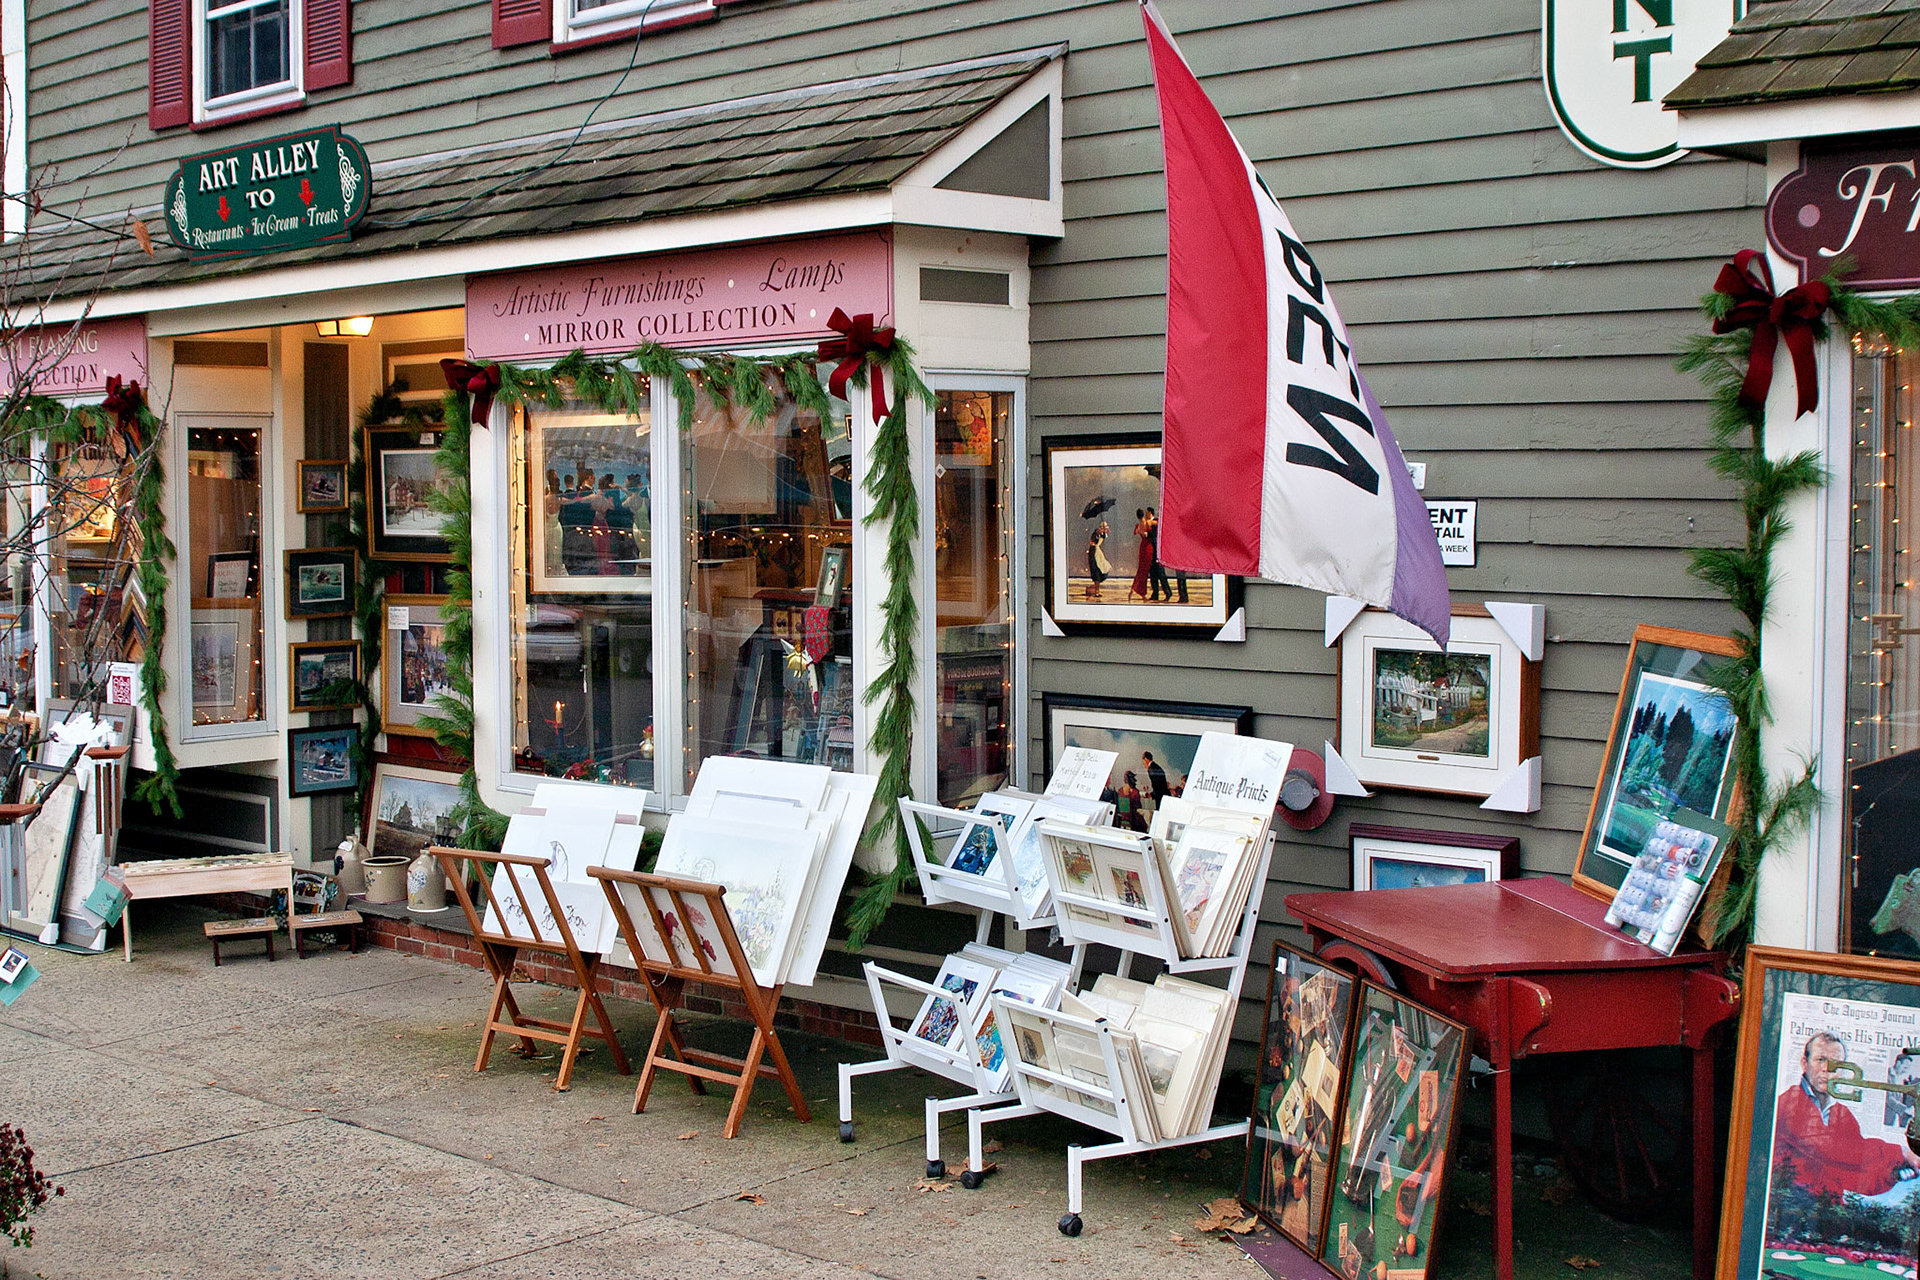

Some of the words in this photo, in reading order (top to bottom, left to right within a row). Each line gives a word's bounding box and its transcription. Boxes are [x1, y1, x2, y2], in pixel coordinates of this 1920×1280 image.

[199, 156, 240, 192] ART
[250, 139, 320, 181] ALLEY
[245, 188, 275, 209] TO
[192, 224, 245, 249] Restaurants
[306, 204, 339, 227] Treats
[493, 282, 571, 317] Artistic
[576, 269, 706, 317] Furnishings
[758, 257, 846, 292] Lamps
[538, 317, 625, 345] MIRROR
[637, 302, 797, 338] COLLECTION
[1192, 769, 1235, 798] Antique
[1236, 777, 1269, 802] Prints
[1822, 1002, 1839, 1016] The
[1842, 1004, 1878, 1020] Augusta
[1880, 1008, 1916, 1024] Journal
[1790, 1020, 1823, 1036] Palm
[1826, 1025, 1852, 1042] ns
[1854, 1028, 1872, 1044] His
[1875, 1031, 1903, 1048] Third
[1906, 1035, 1920, 1049] M
